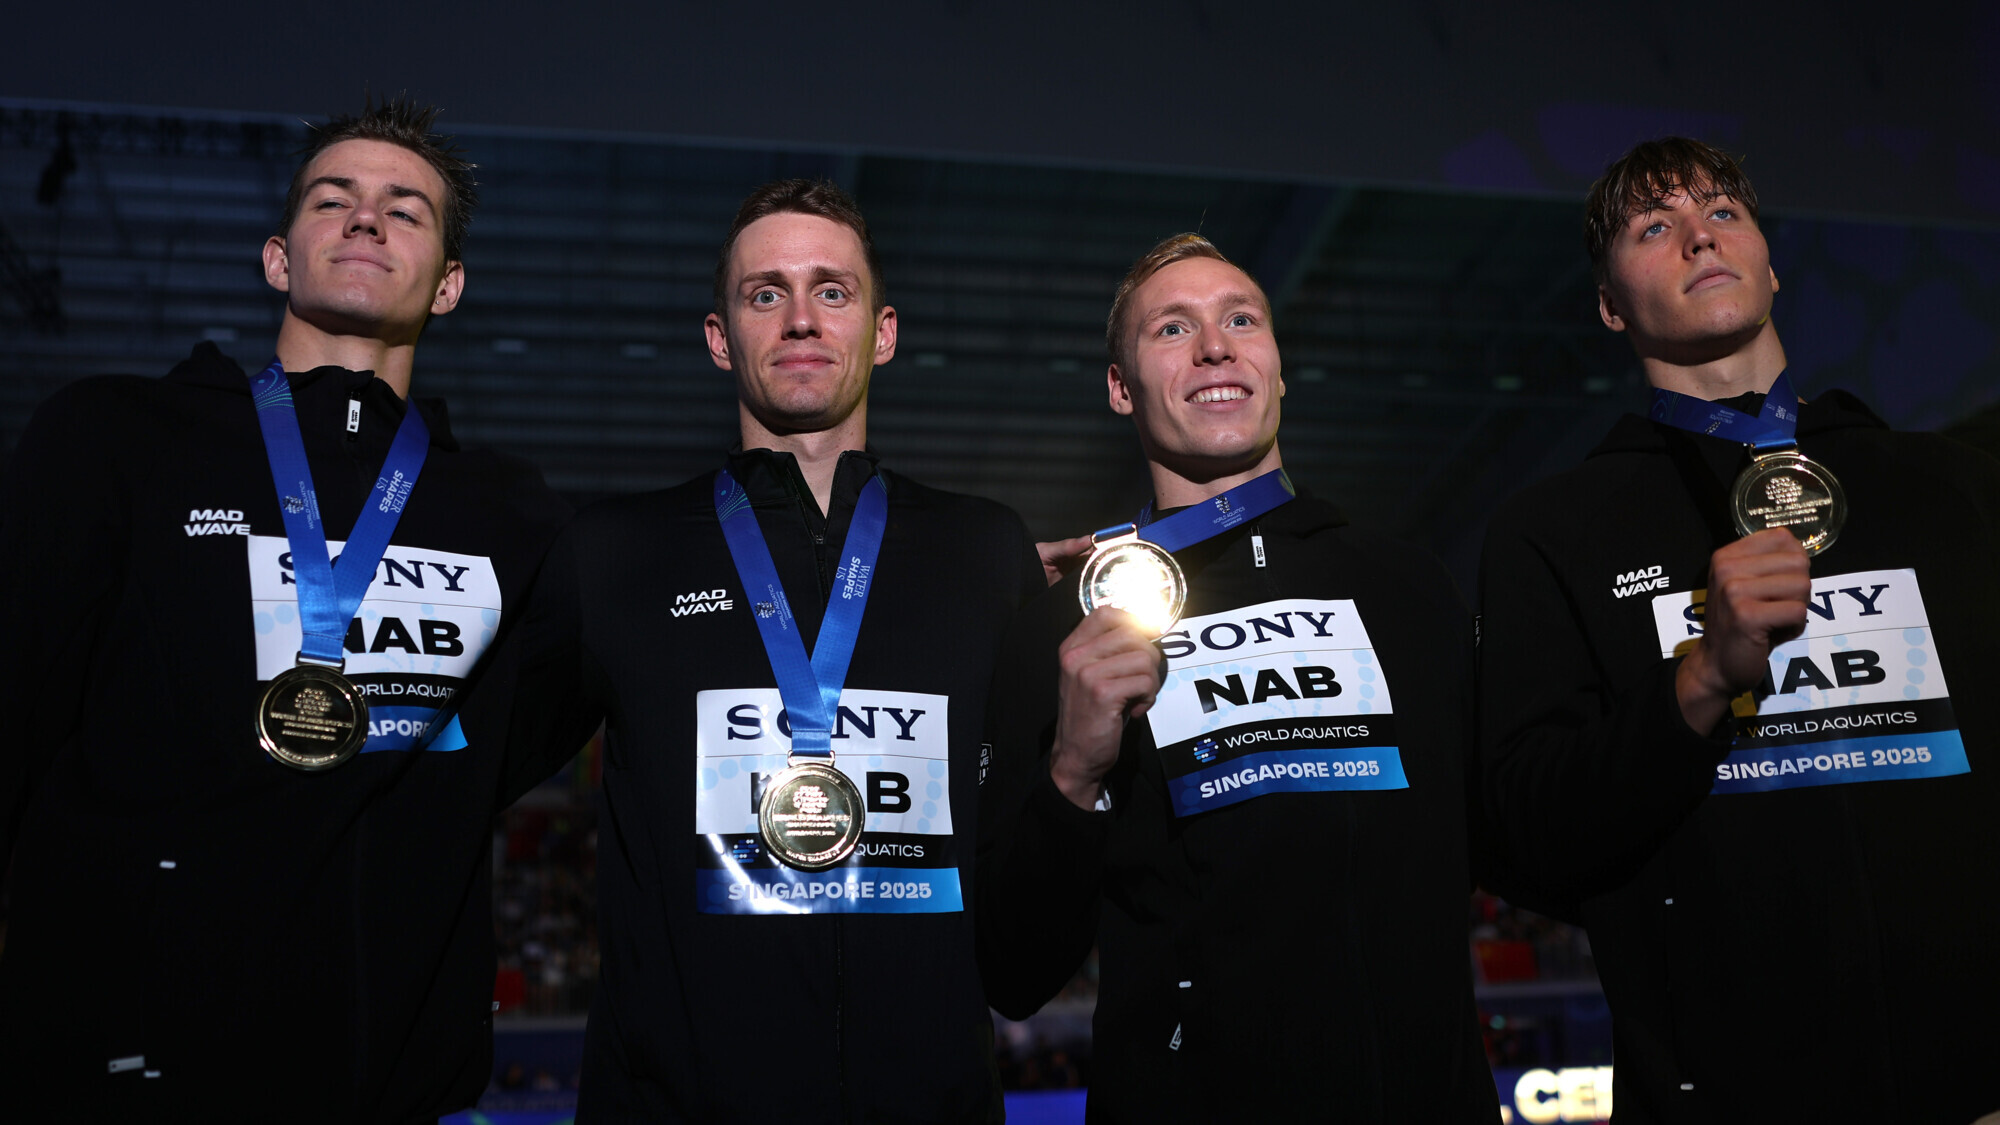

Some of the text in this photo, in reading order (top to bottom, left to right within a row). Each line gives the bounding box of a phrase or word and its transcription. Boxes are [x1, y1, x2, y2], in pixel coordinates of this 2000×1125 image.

[375, 476, 389, 492] US
[378, 469, 404, 514] SHAPES
[389, 480, 413, 514] WATER
[190, 509, 244, 522] MAD
[184, 523, 251, 537] WAVE
[278, 551, 470, 592] NY
[835, 566, 847, 581] US
[842, 556, 861, 600] SHAPES
[853, 565, 871, 598] WATER
[1616, 565, 1662, 586] MAD
[675, 589, 726, 605] MAD
[1612, 576, 1670, 599] WAVE
[669, 599, 734, 618] WAVE
[1683, 584, 1890, 636] SNY
[1161, 611, 1336, 659] SONY
[355, 684, 404, 696] ORLD
[1194, 665, 1343, 714] NAB
[726, 703, 926, 742] SNY
[1747, 711, 1918, 738] WORLD AQUATICS
[1224, 725, 1370, 749] WORLD AQUATICS
[1716, 746, 1933, 781] SINGAPORE 2025
[1200, 760, 1380, 799] SINGAPORE 2025
[854, 843, 925, 858] QUATICS
[727, 881, 933, 901] SINGAPORE 2025
